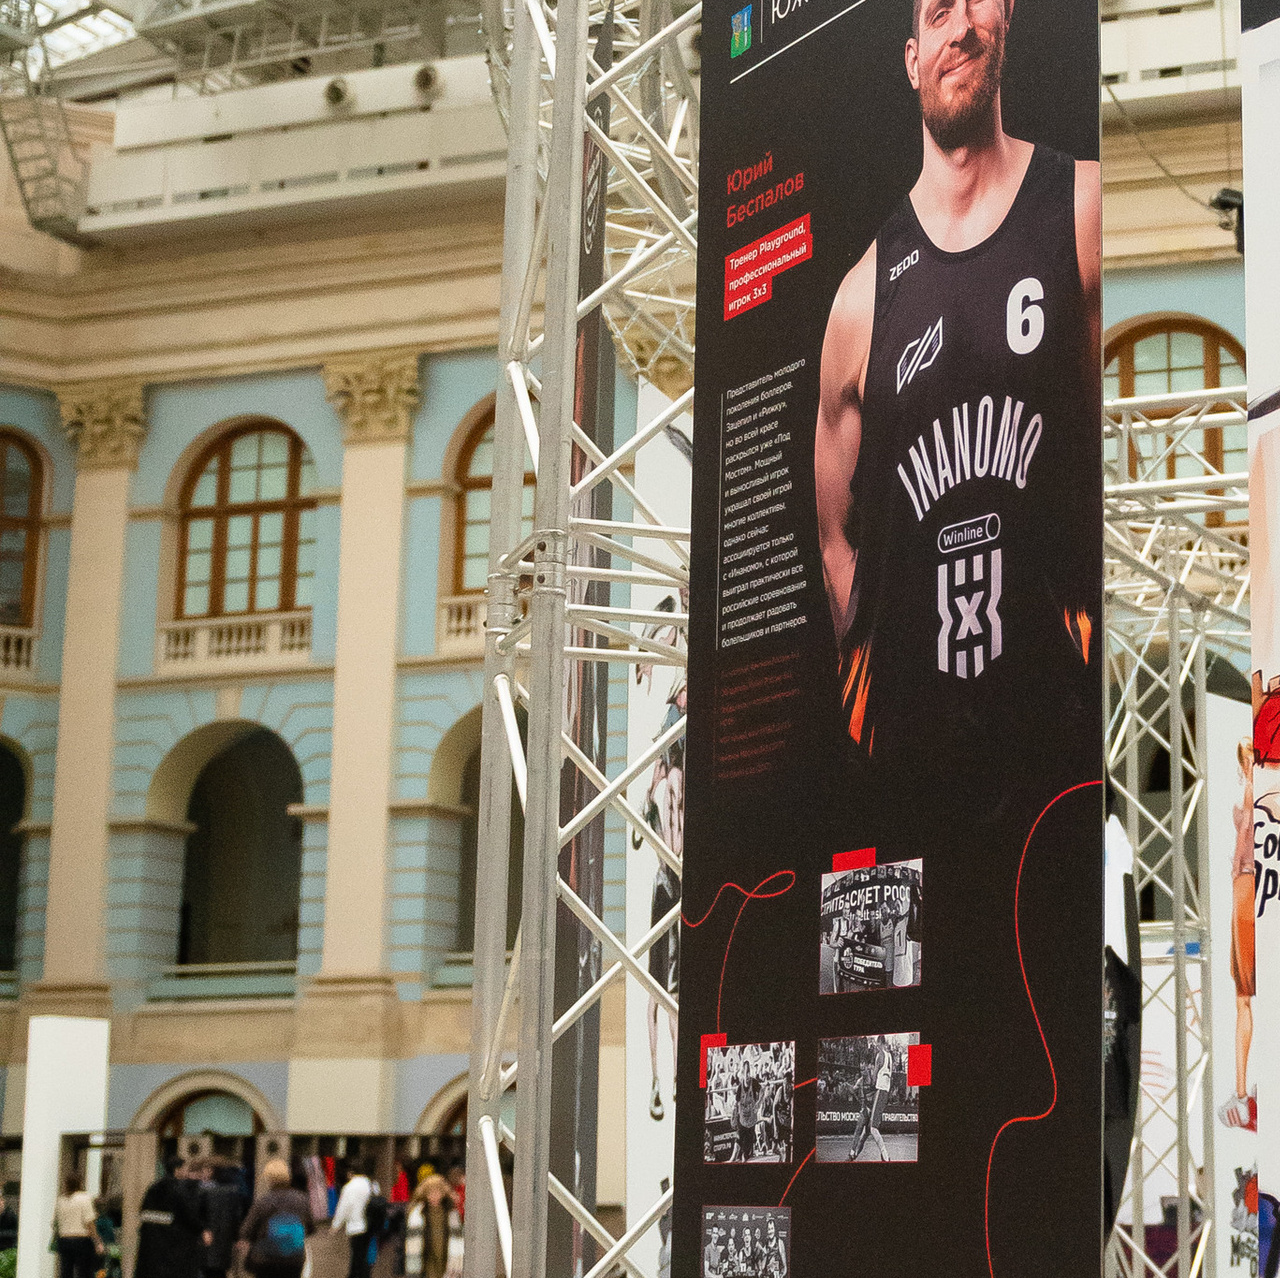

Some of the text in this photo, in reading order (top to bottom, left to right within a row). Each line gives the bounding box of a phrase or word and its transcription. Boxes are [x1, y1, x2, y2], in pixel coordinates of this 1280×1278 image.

[727, 150, 773, 195] Юрий
[726, 172, 804, 228] Беспалов
[728, 242, 807, 291] профессиональный
[729, 221, 806, 270] Тренер Playground,
[728, 283, 767, 312] игрок 3x3
[1006, 277, 1045, 355] 6
[897, 394, 1043, 522] INANOMO
[942, 524, 984, 548] Winline
